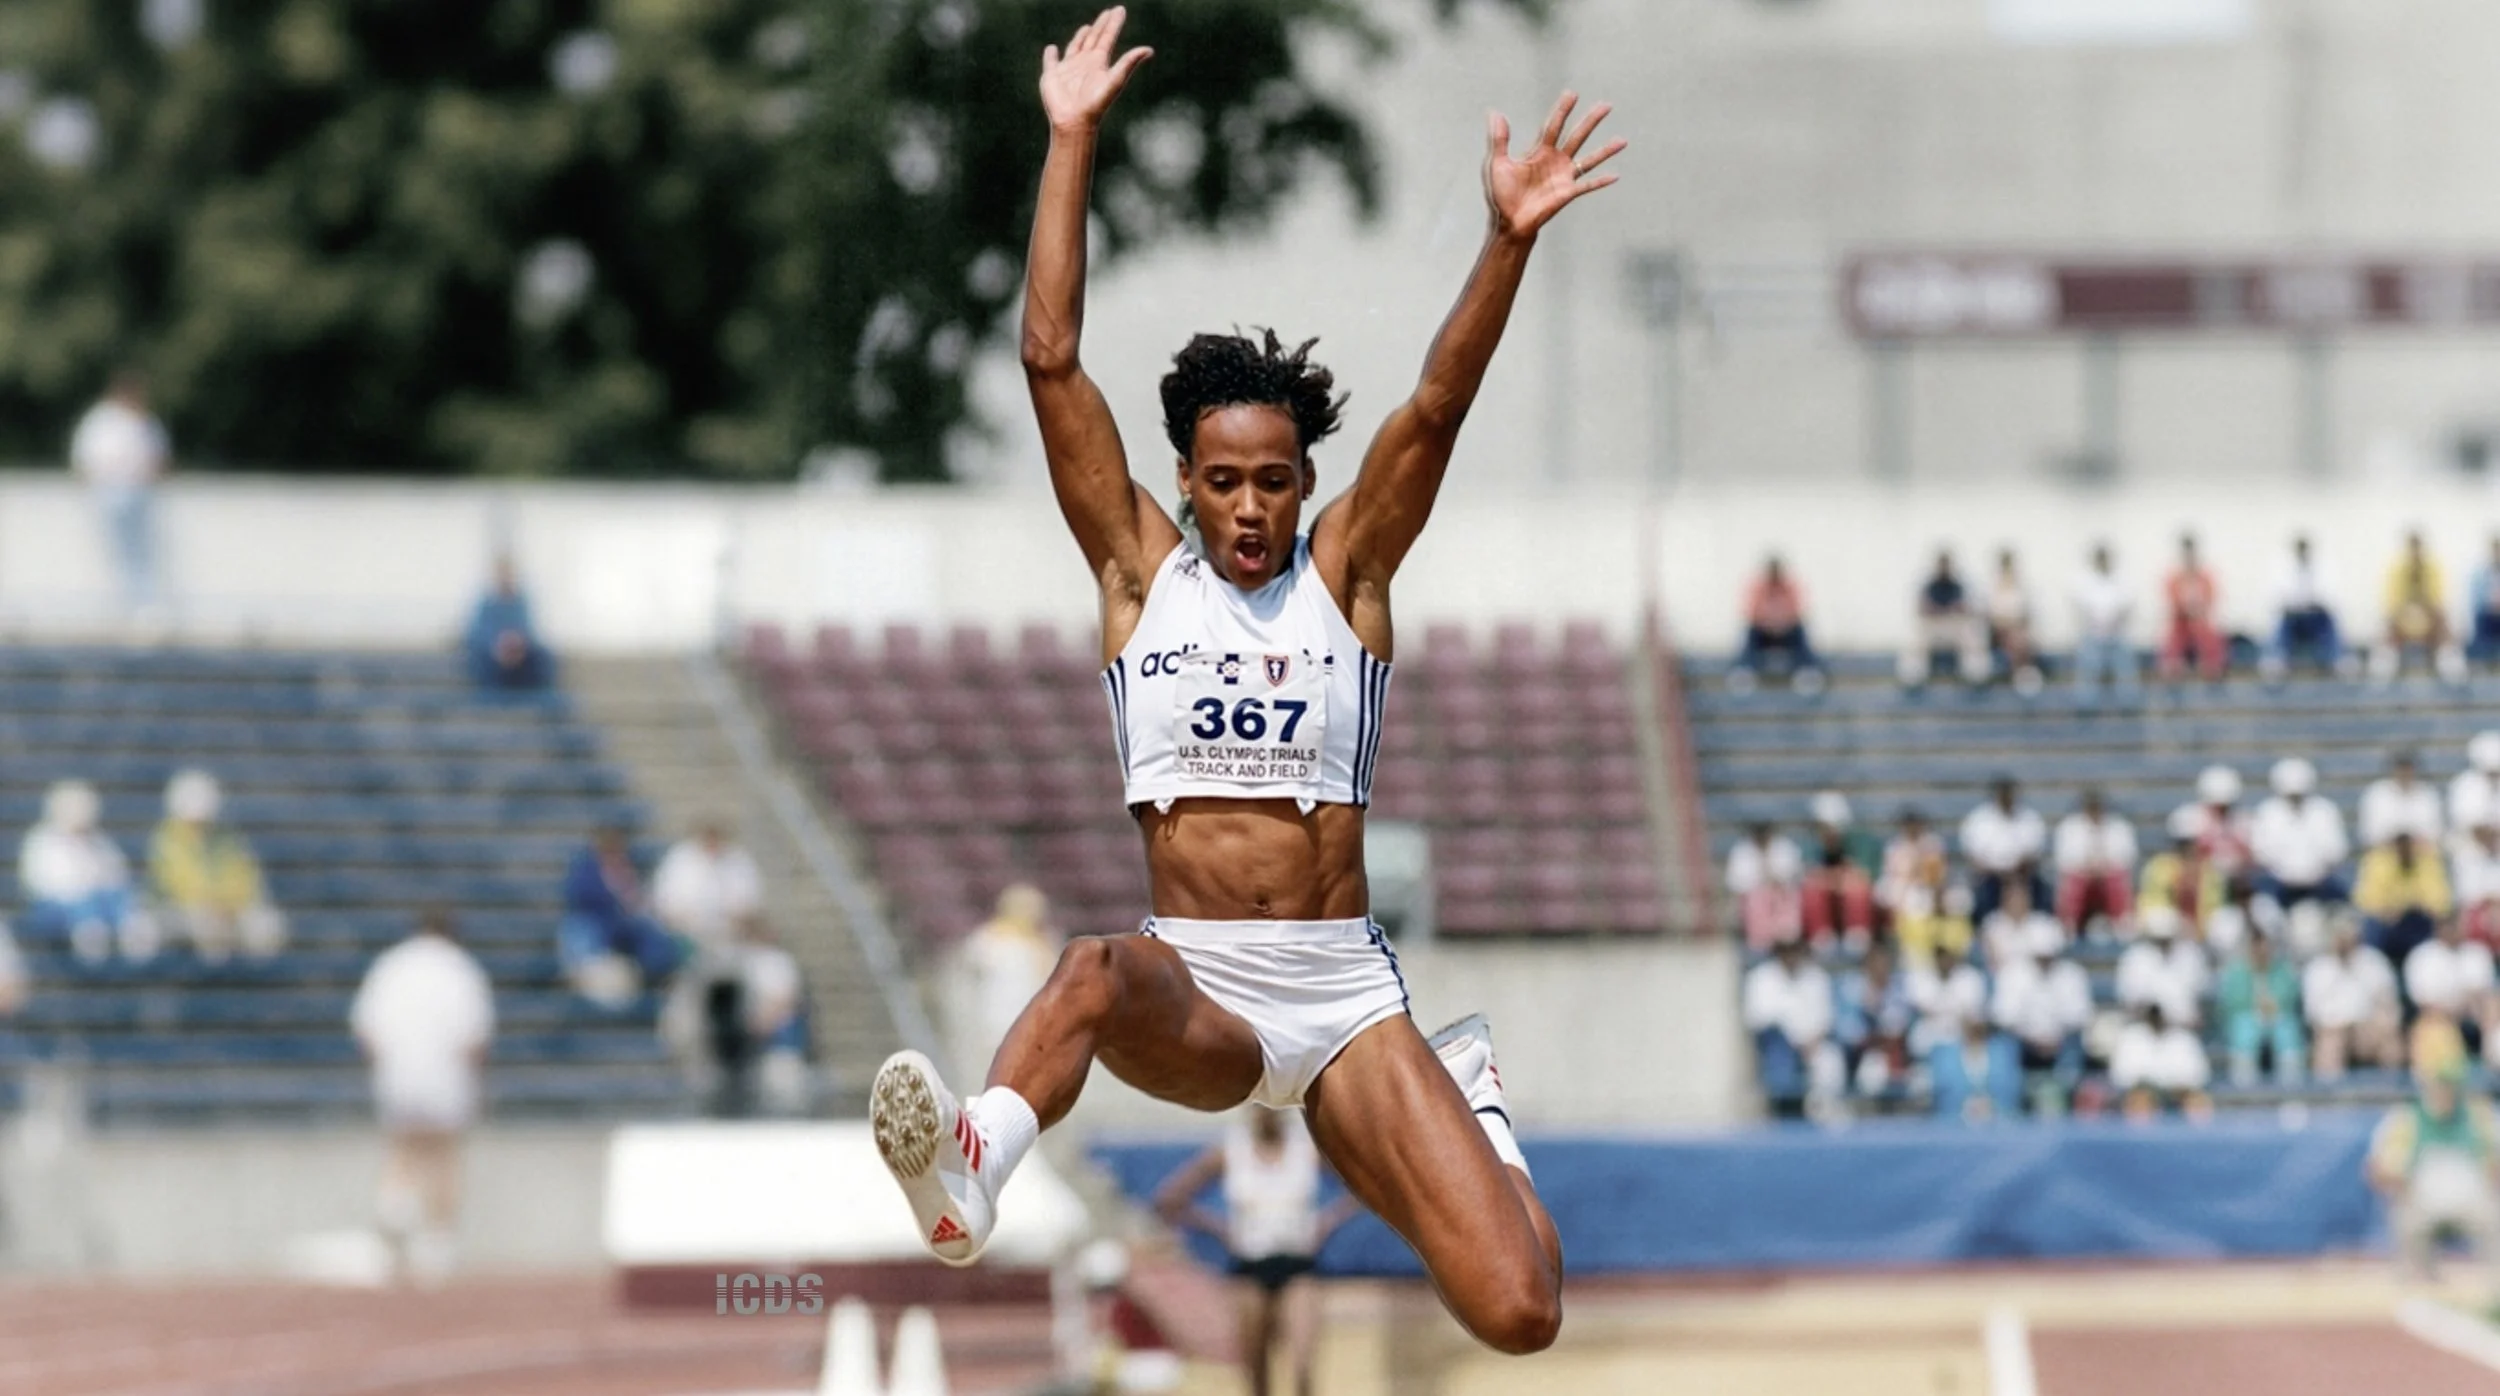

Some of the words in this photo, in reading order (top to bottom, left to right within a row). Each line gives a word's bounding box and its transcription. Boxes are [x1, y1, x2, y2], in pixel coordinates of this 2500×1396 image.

[1190, 697, 1308, 743] 367
[1179, 745, 1204, 759] U.S.
[1270, 748, 1317, 762] TRIALS
[1188, 761, 1234, 777] TRACK
[1237, 764, 1267, 778] AND
[1269, 764, 1308, 778] FIELD
